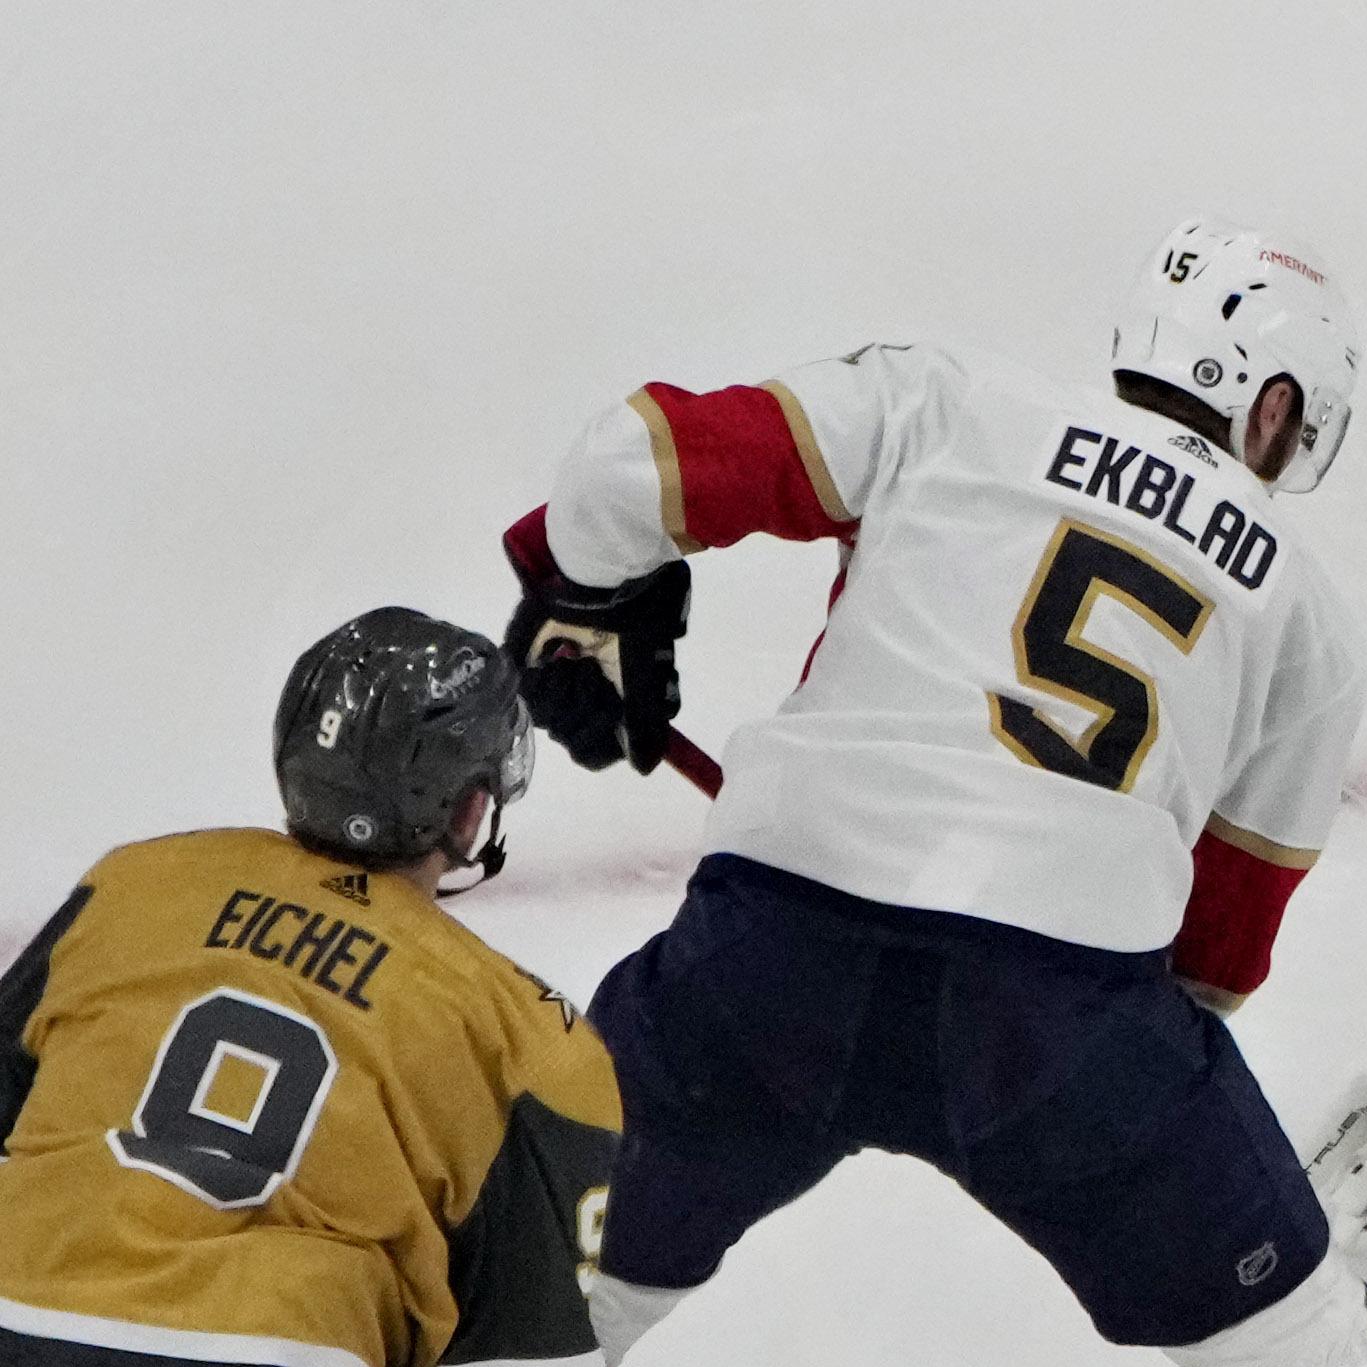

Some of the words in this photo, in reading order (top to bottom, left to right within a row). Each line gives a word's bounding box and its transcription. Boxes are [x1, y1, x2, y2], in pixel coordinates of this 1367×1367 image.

[1045, 426, 1277, 590] EKBLAD
[986, 516, 1217, 794] 5
[316, 710, 342, 749] 9
[204, 890, 393, 1010] EICHEL
